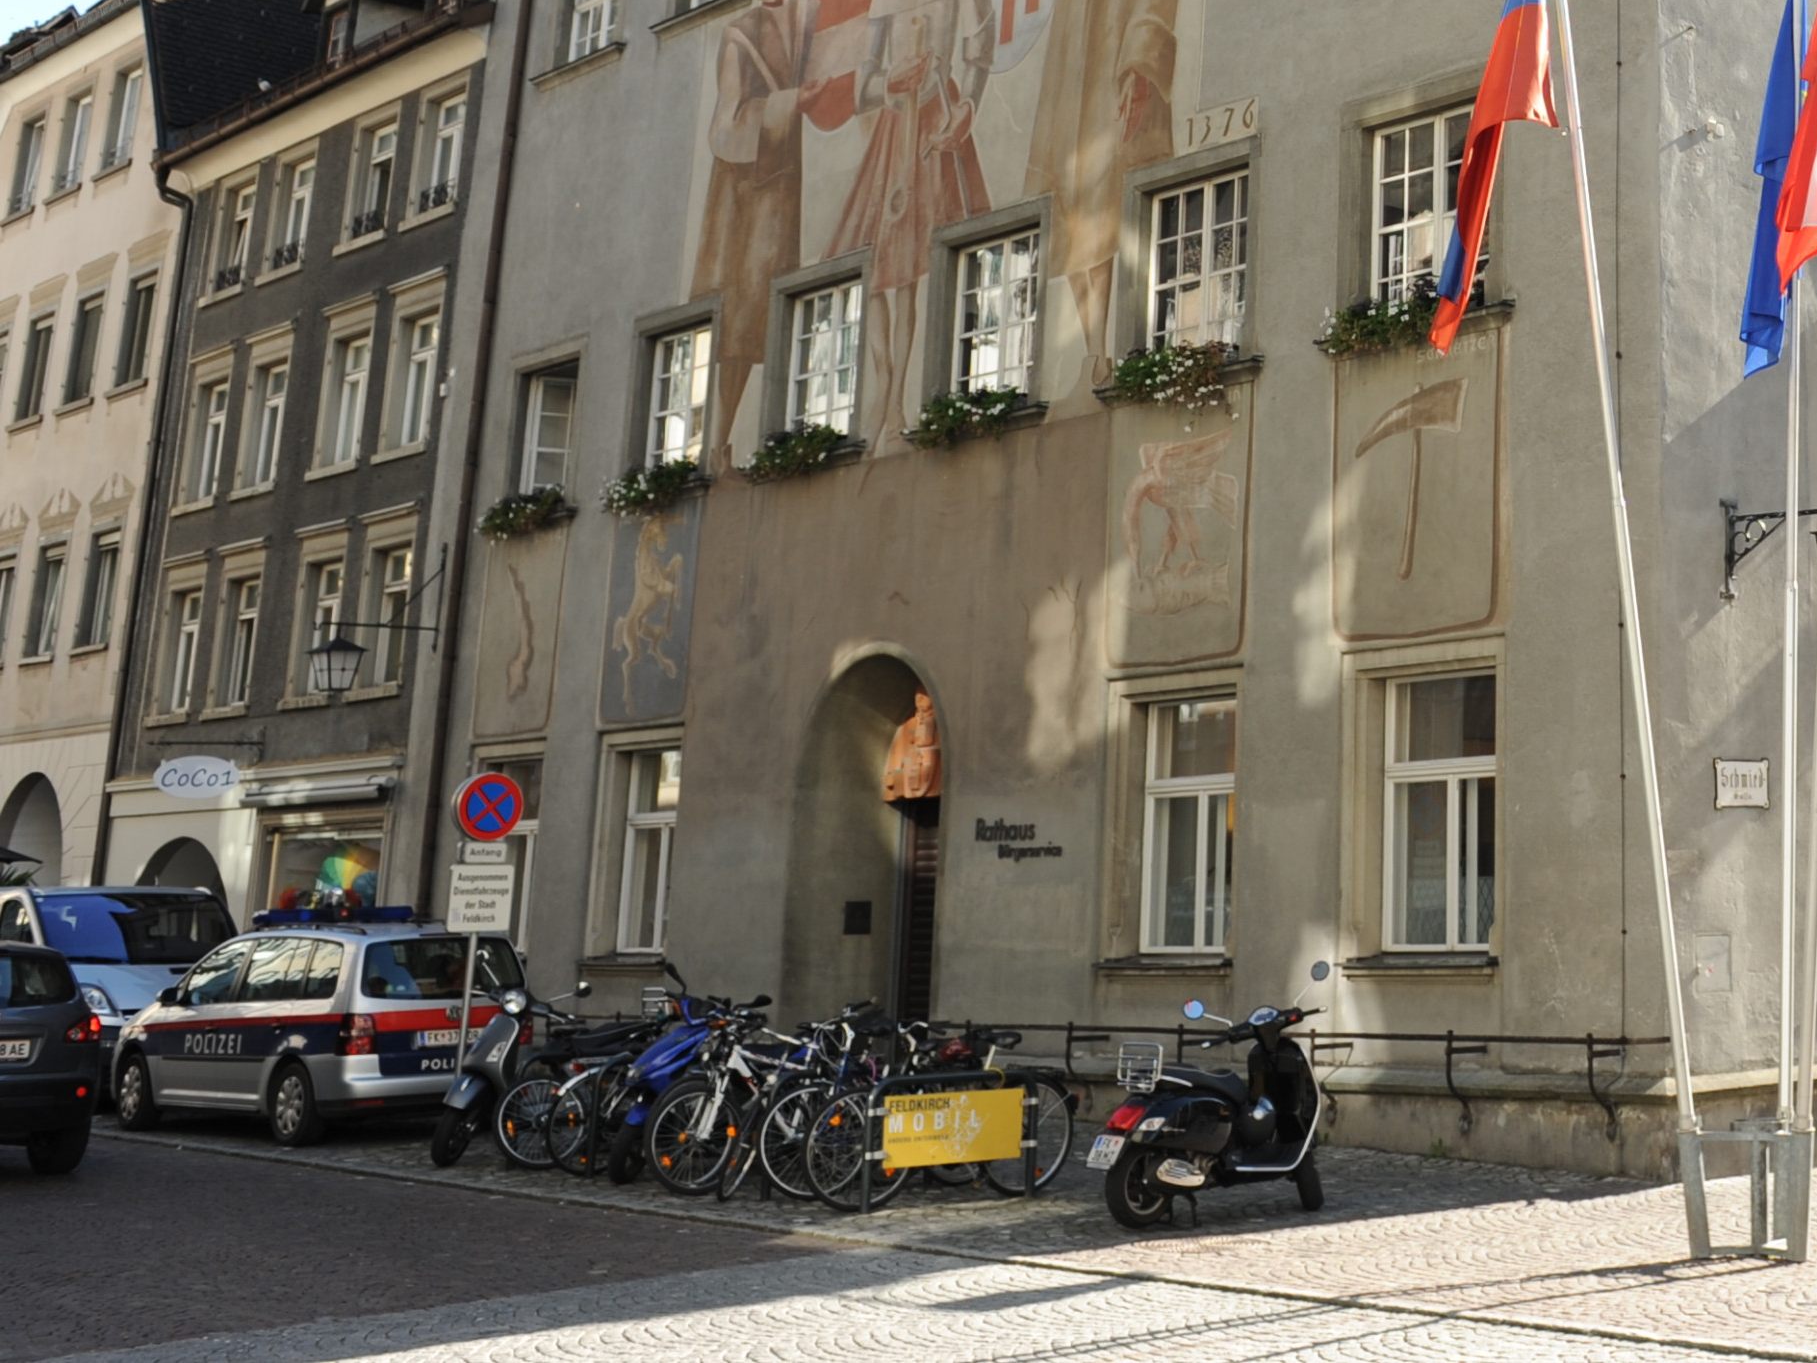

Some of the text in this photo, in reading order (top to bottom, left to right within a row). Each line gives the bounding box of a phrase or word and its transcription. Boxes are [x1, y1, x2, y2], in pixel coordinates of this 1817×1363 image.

[1185, 98, 1255, 147] 1376
[975, 818, 1035, 842] Rathaus
[470, 848, 502, 858] Anfang
[457, 873, 509, 884] Ausgenommen
[453, 886, 509, 897] Dienstfahrzeuge
[465, 900, 496, 909] der Stadt
[463, 914, 495, 923] Feldkirch
[184, 1033, 243, 1054] POLIZEI
[421, 1058, 455, 1070] POLI
[890, 1098, 950, 1112] FELDKIRCH
